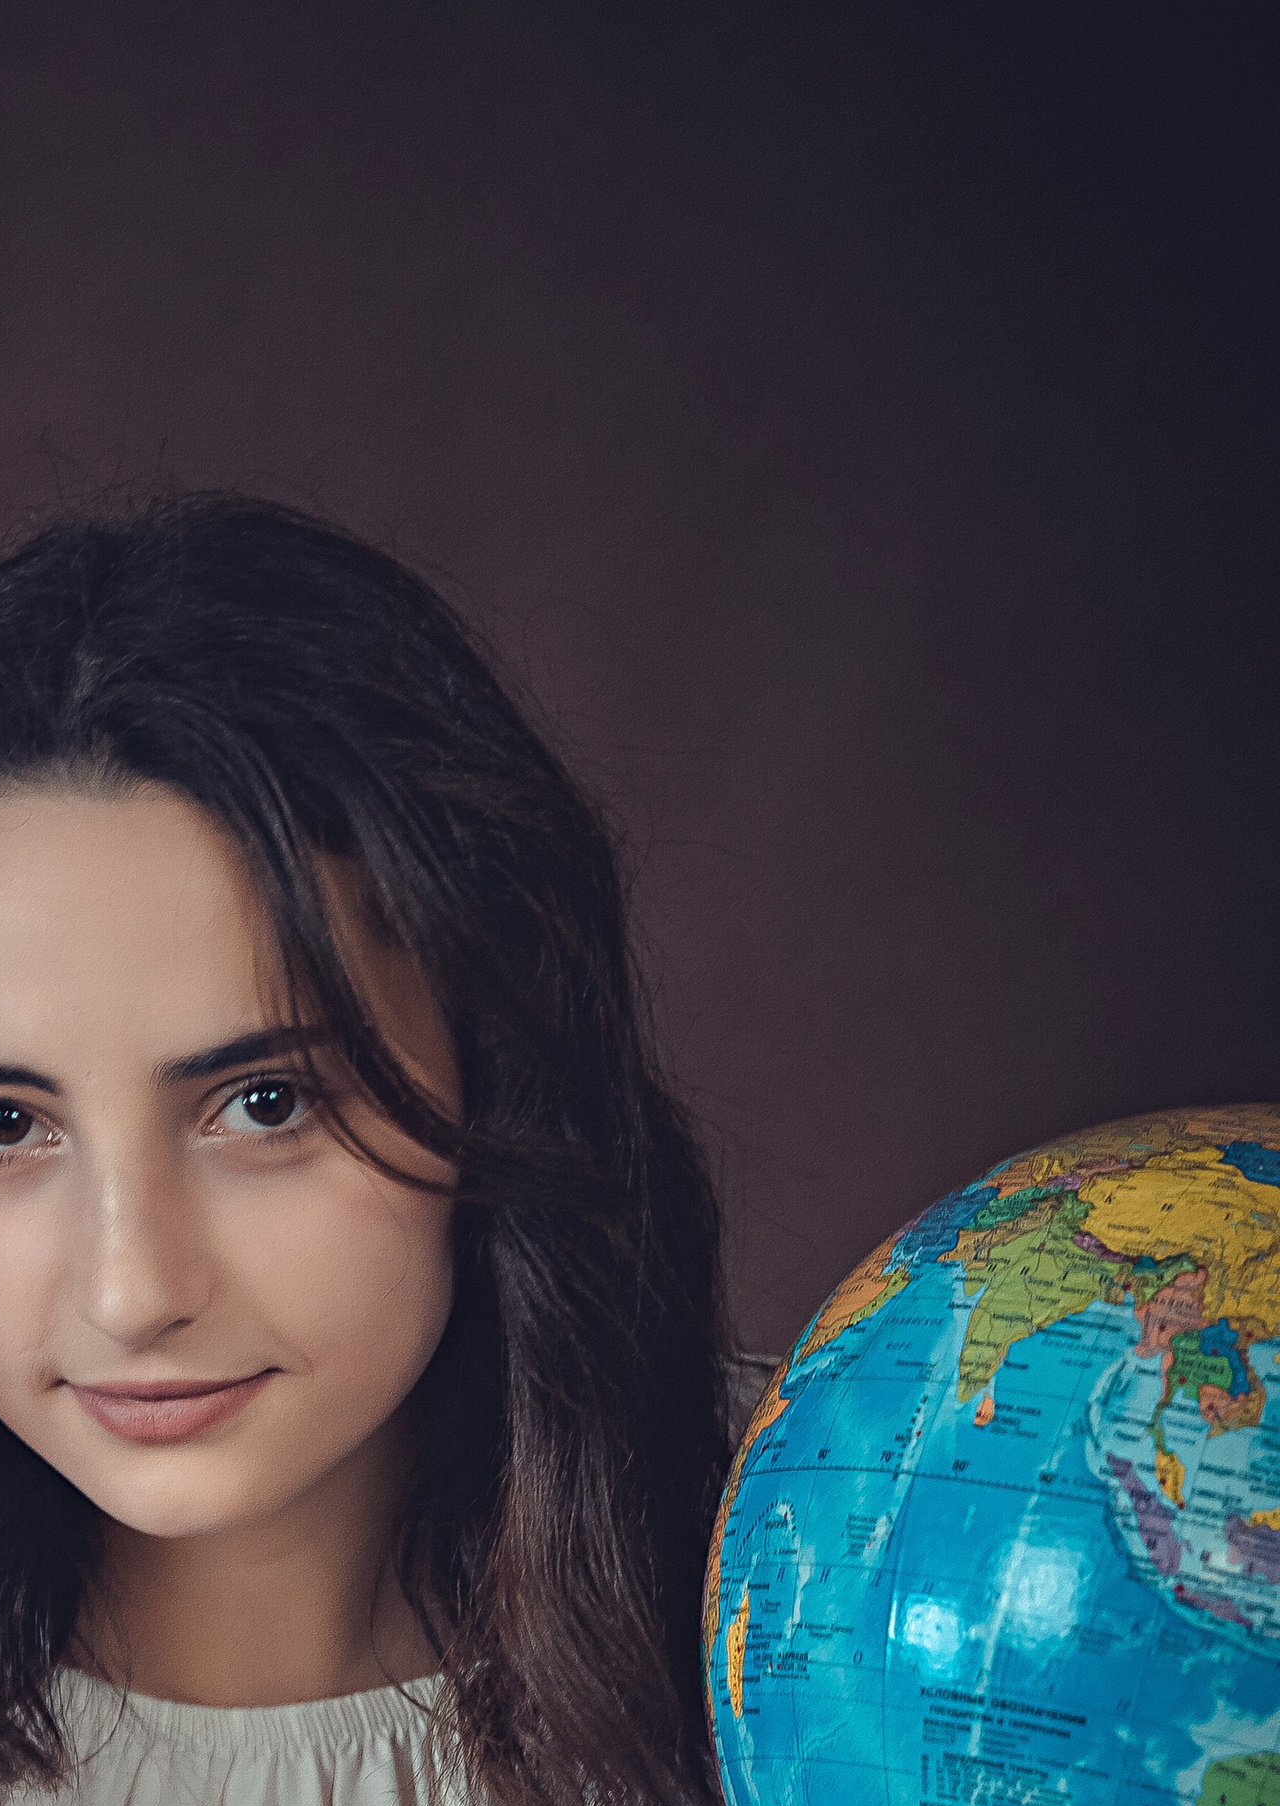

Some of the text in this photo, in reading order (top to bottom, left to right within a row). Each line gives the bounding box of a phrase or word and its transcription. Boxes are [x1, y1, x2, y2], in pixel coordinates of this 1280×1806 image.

[920, 1686, 1087, 1726] УСЛОВНЫЕ ОБОЗНАЧЕНИЯ
[929, 1704, 993, 1723] ГОСУДАРСТВА
